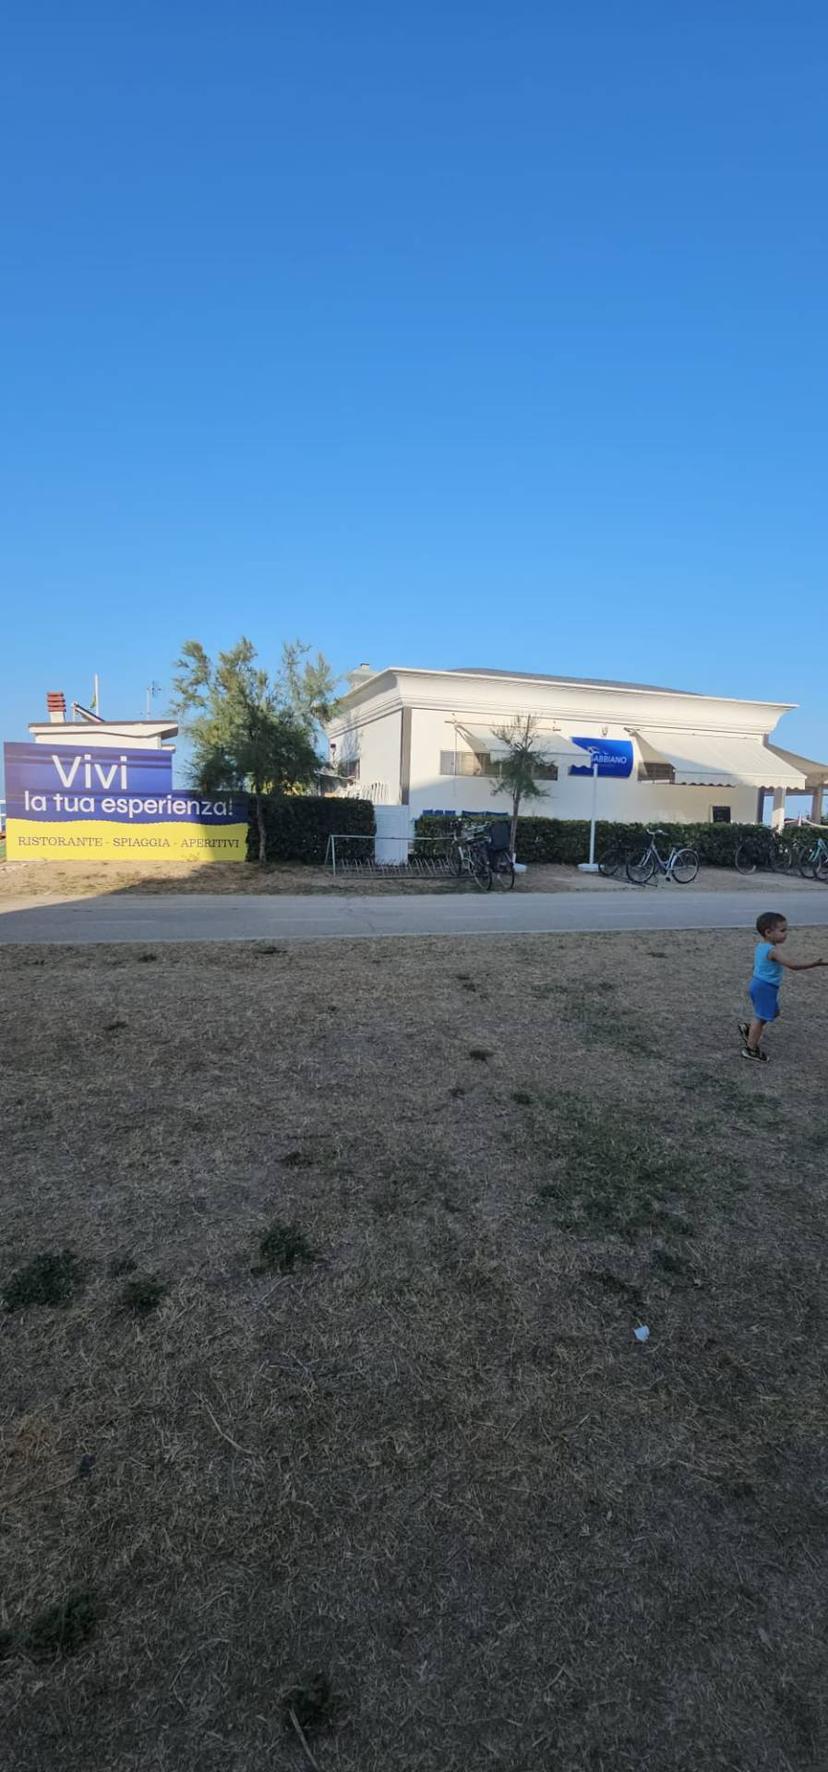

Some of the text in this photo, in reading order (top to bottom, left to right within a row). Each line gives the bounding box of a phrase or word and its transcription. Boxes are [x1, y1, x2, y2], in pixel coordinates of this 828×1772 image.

[591, 754, 627, 765] ABBIANO
[52, 754, 127, 790] Vivi
[24, 790, 233, 818] la tua esperienza!
[18, 836, 103, 847] RISTORANTE
[112, 837, 170, 848] SPIAGGIA
[181, 838, 239, 848] APERITIVI
